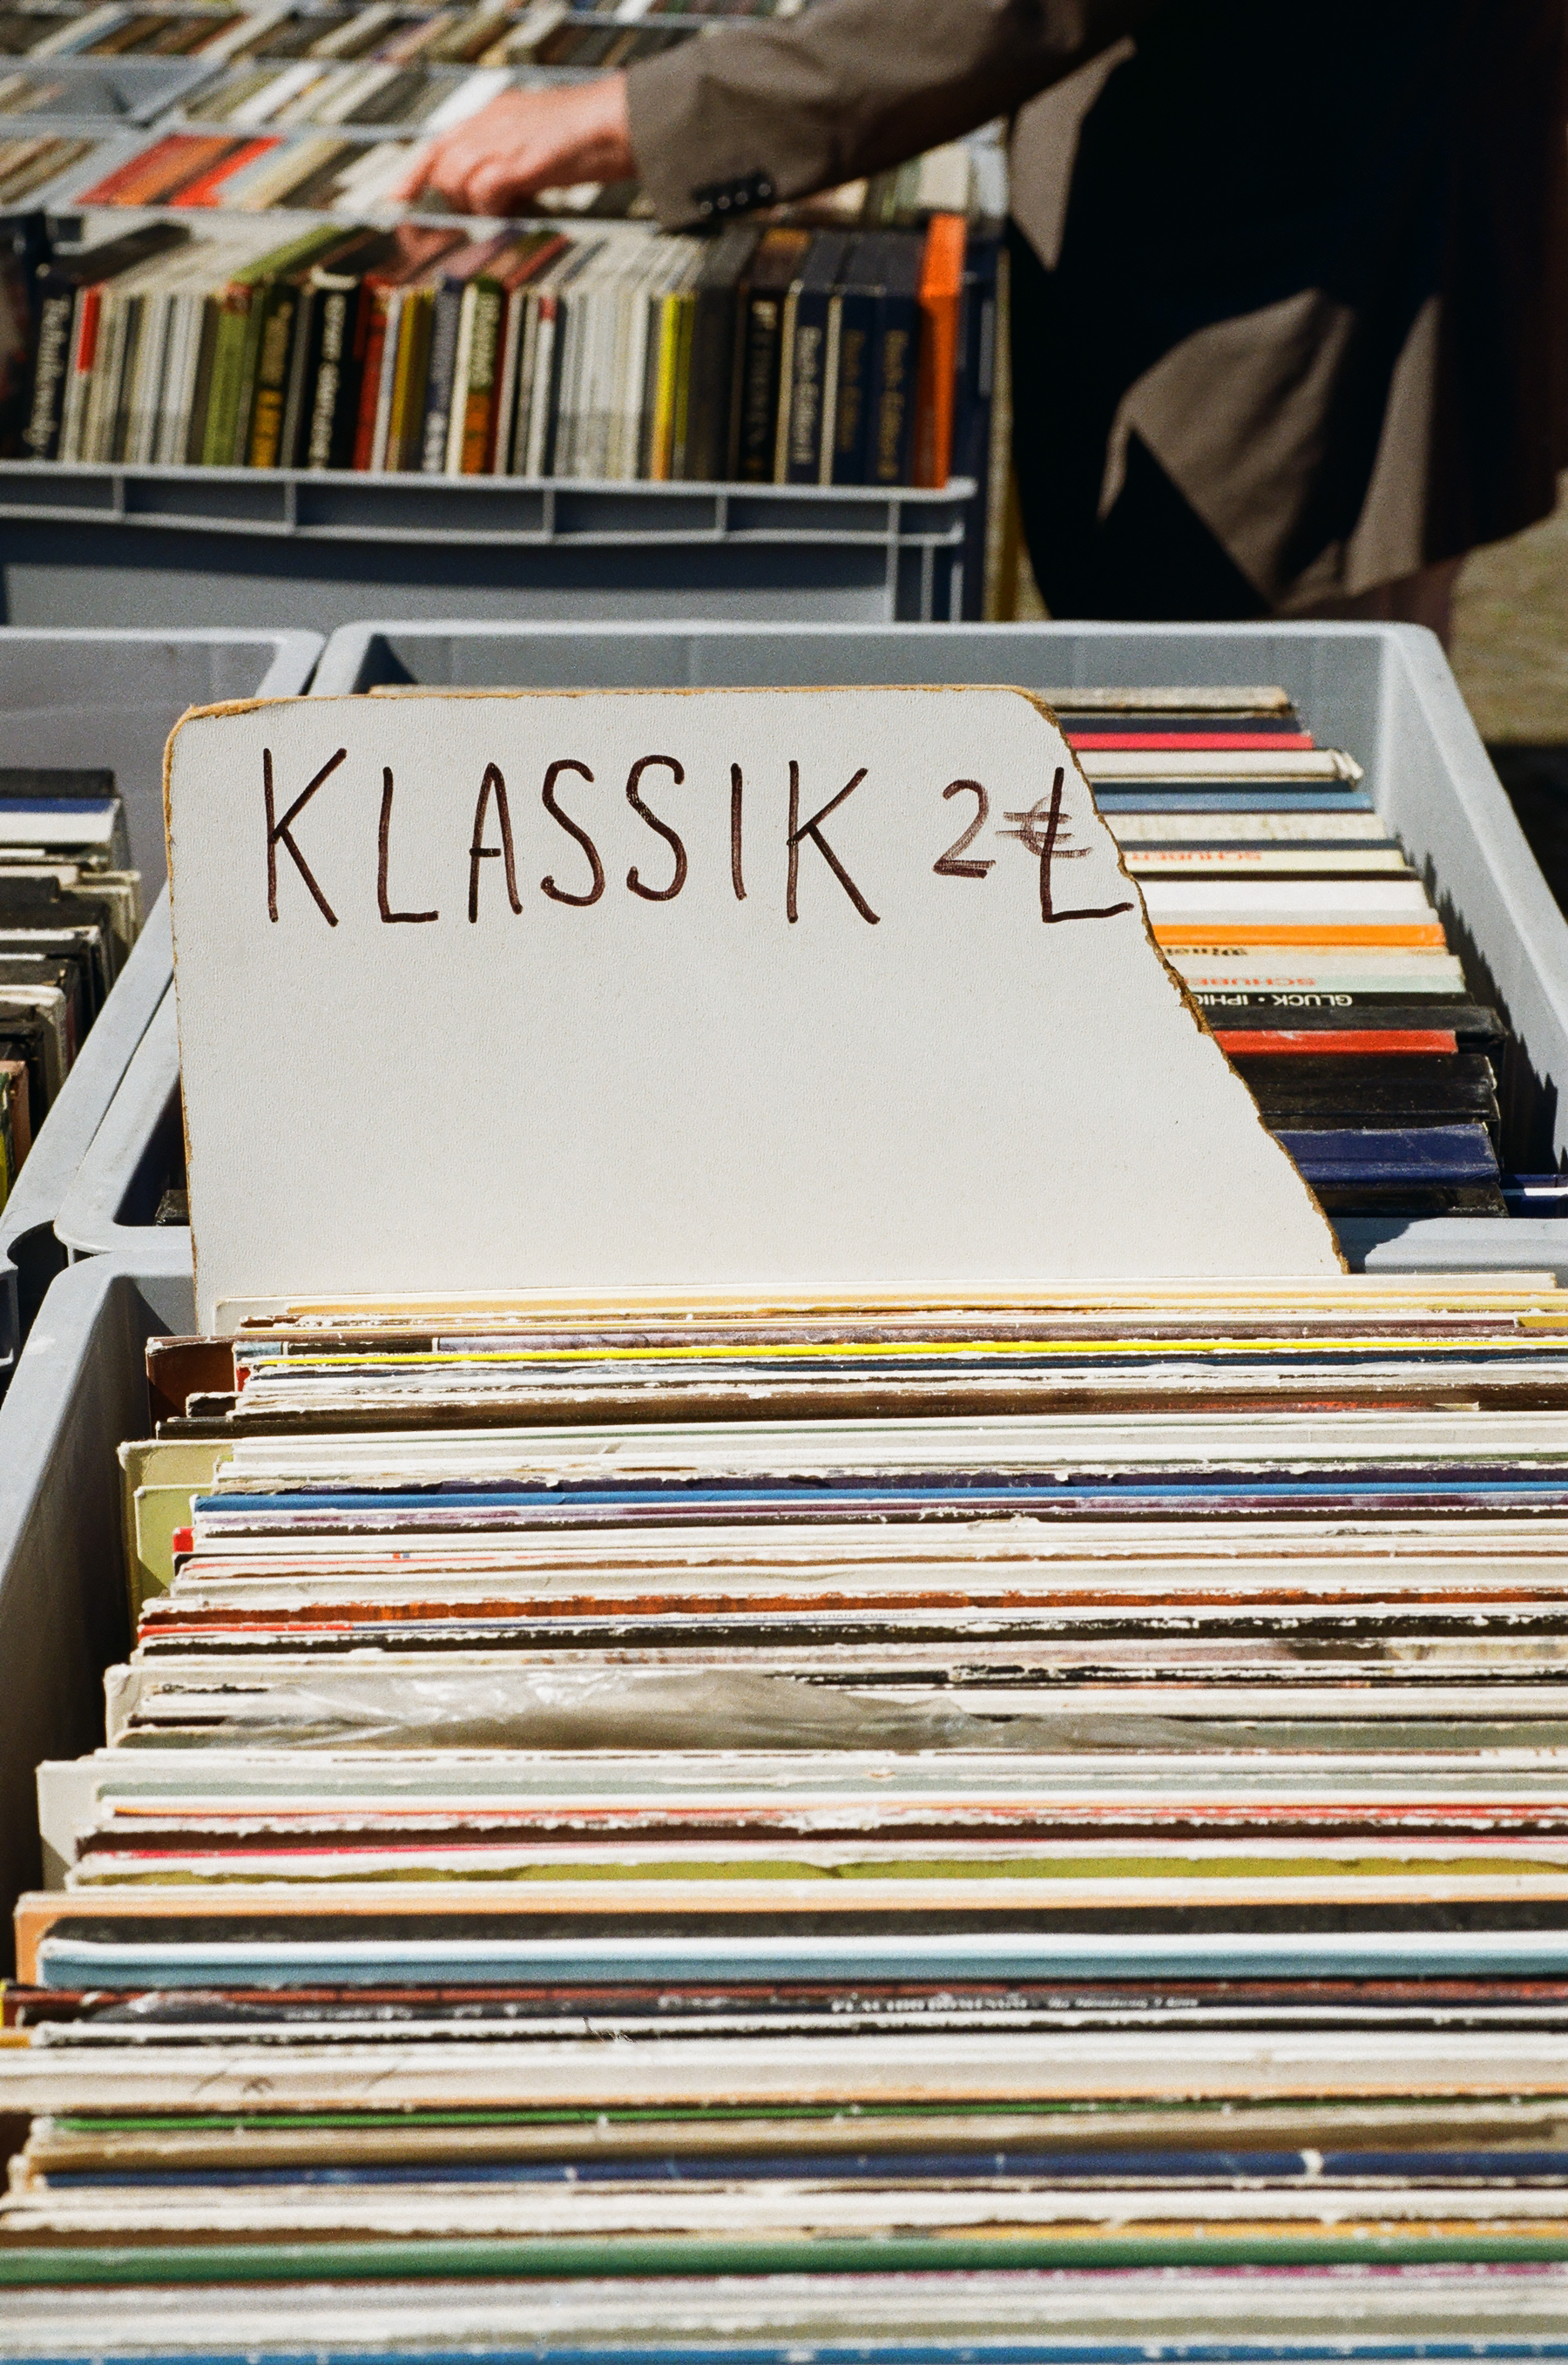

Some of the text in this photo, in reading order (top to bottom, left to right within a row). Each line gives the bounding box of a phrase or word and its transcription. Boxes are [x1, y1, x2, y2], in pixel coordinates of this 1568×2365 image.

[263, 747, 881, 926] KLASSIK
[1125, 850, 1262, 862] SCHUBER
[1272, 994, 1353, 1007] GLUCK
